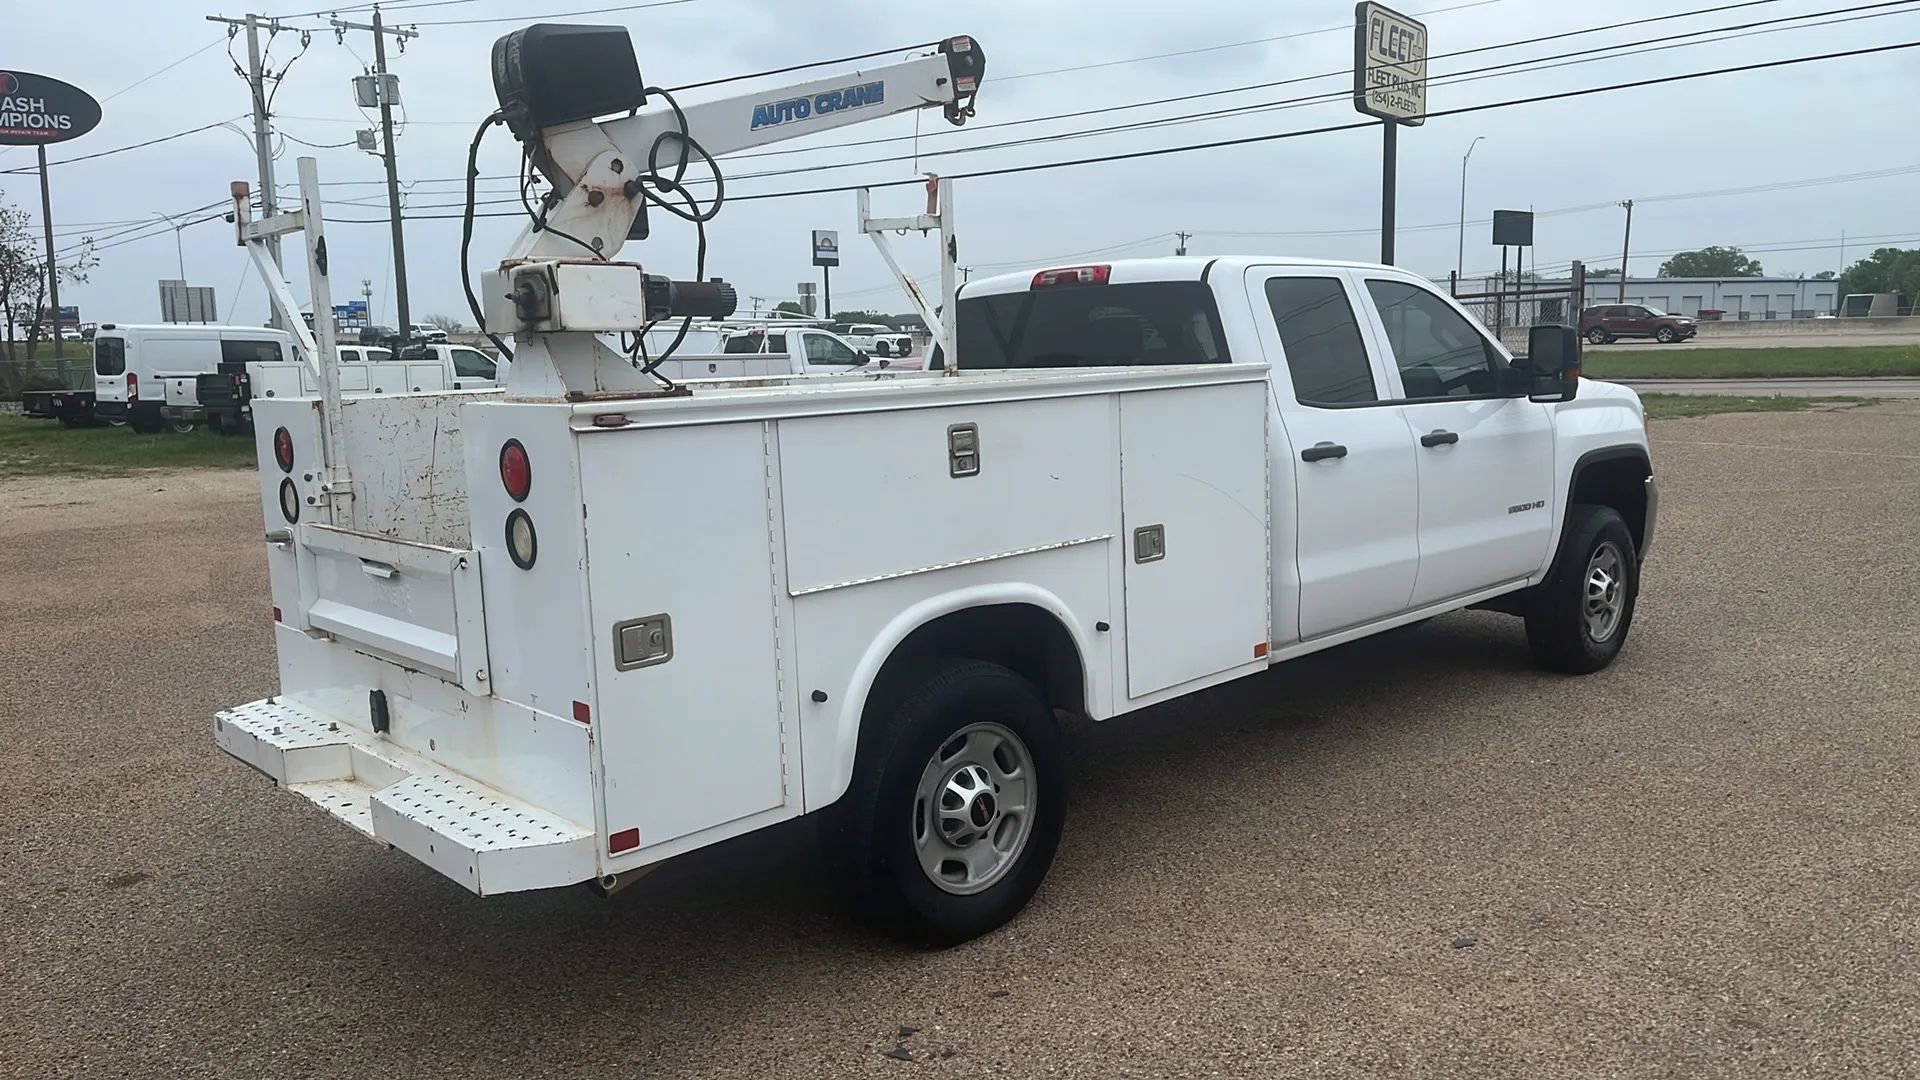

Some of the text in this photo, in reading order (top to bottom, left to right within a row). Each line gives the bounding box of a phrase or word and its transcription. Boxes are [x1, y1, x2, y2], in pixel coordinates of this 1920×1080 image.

[1368, 68, 1391, 86] FLEET
[1, 96, 45, 113] ASH
[751, 80, 884, 130] AUTO CRANE
[1372, 90, 1417, 114] (254) 2-FLEETS
